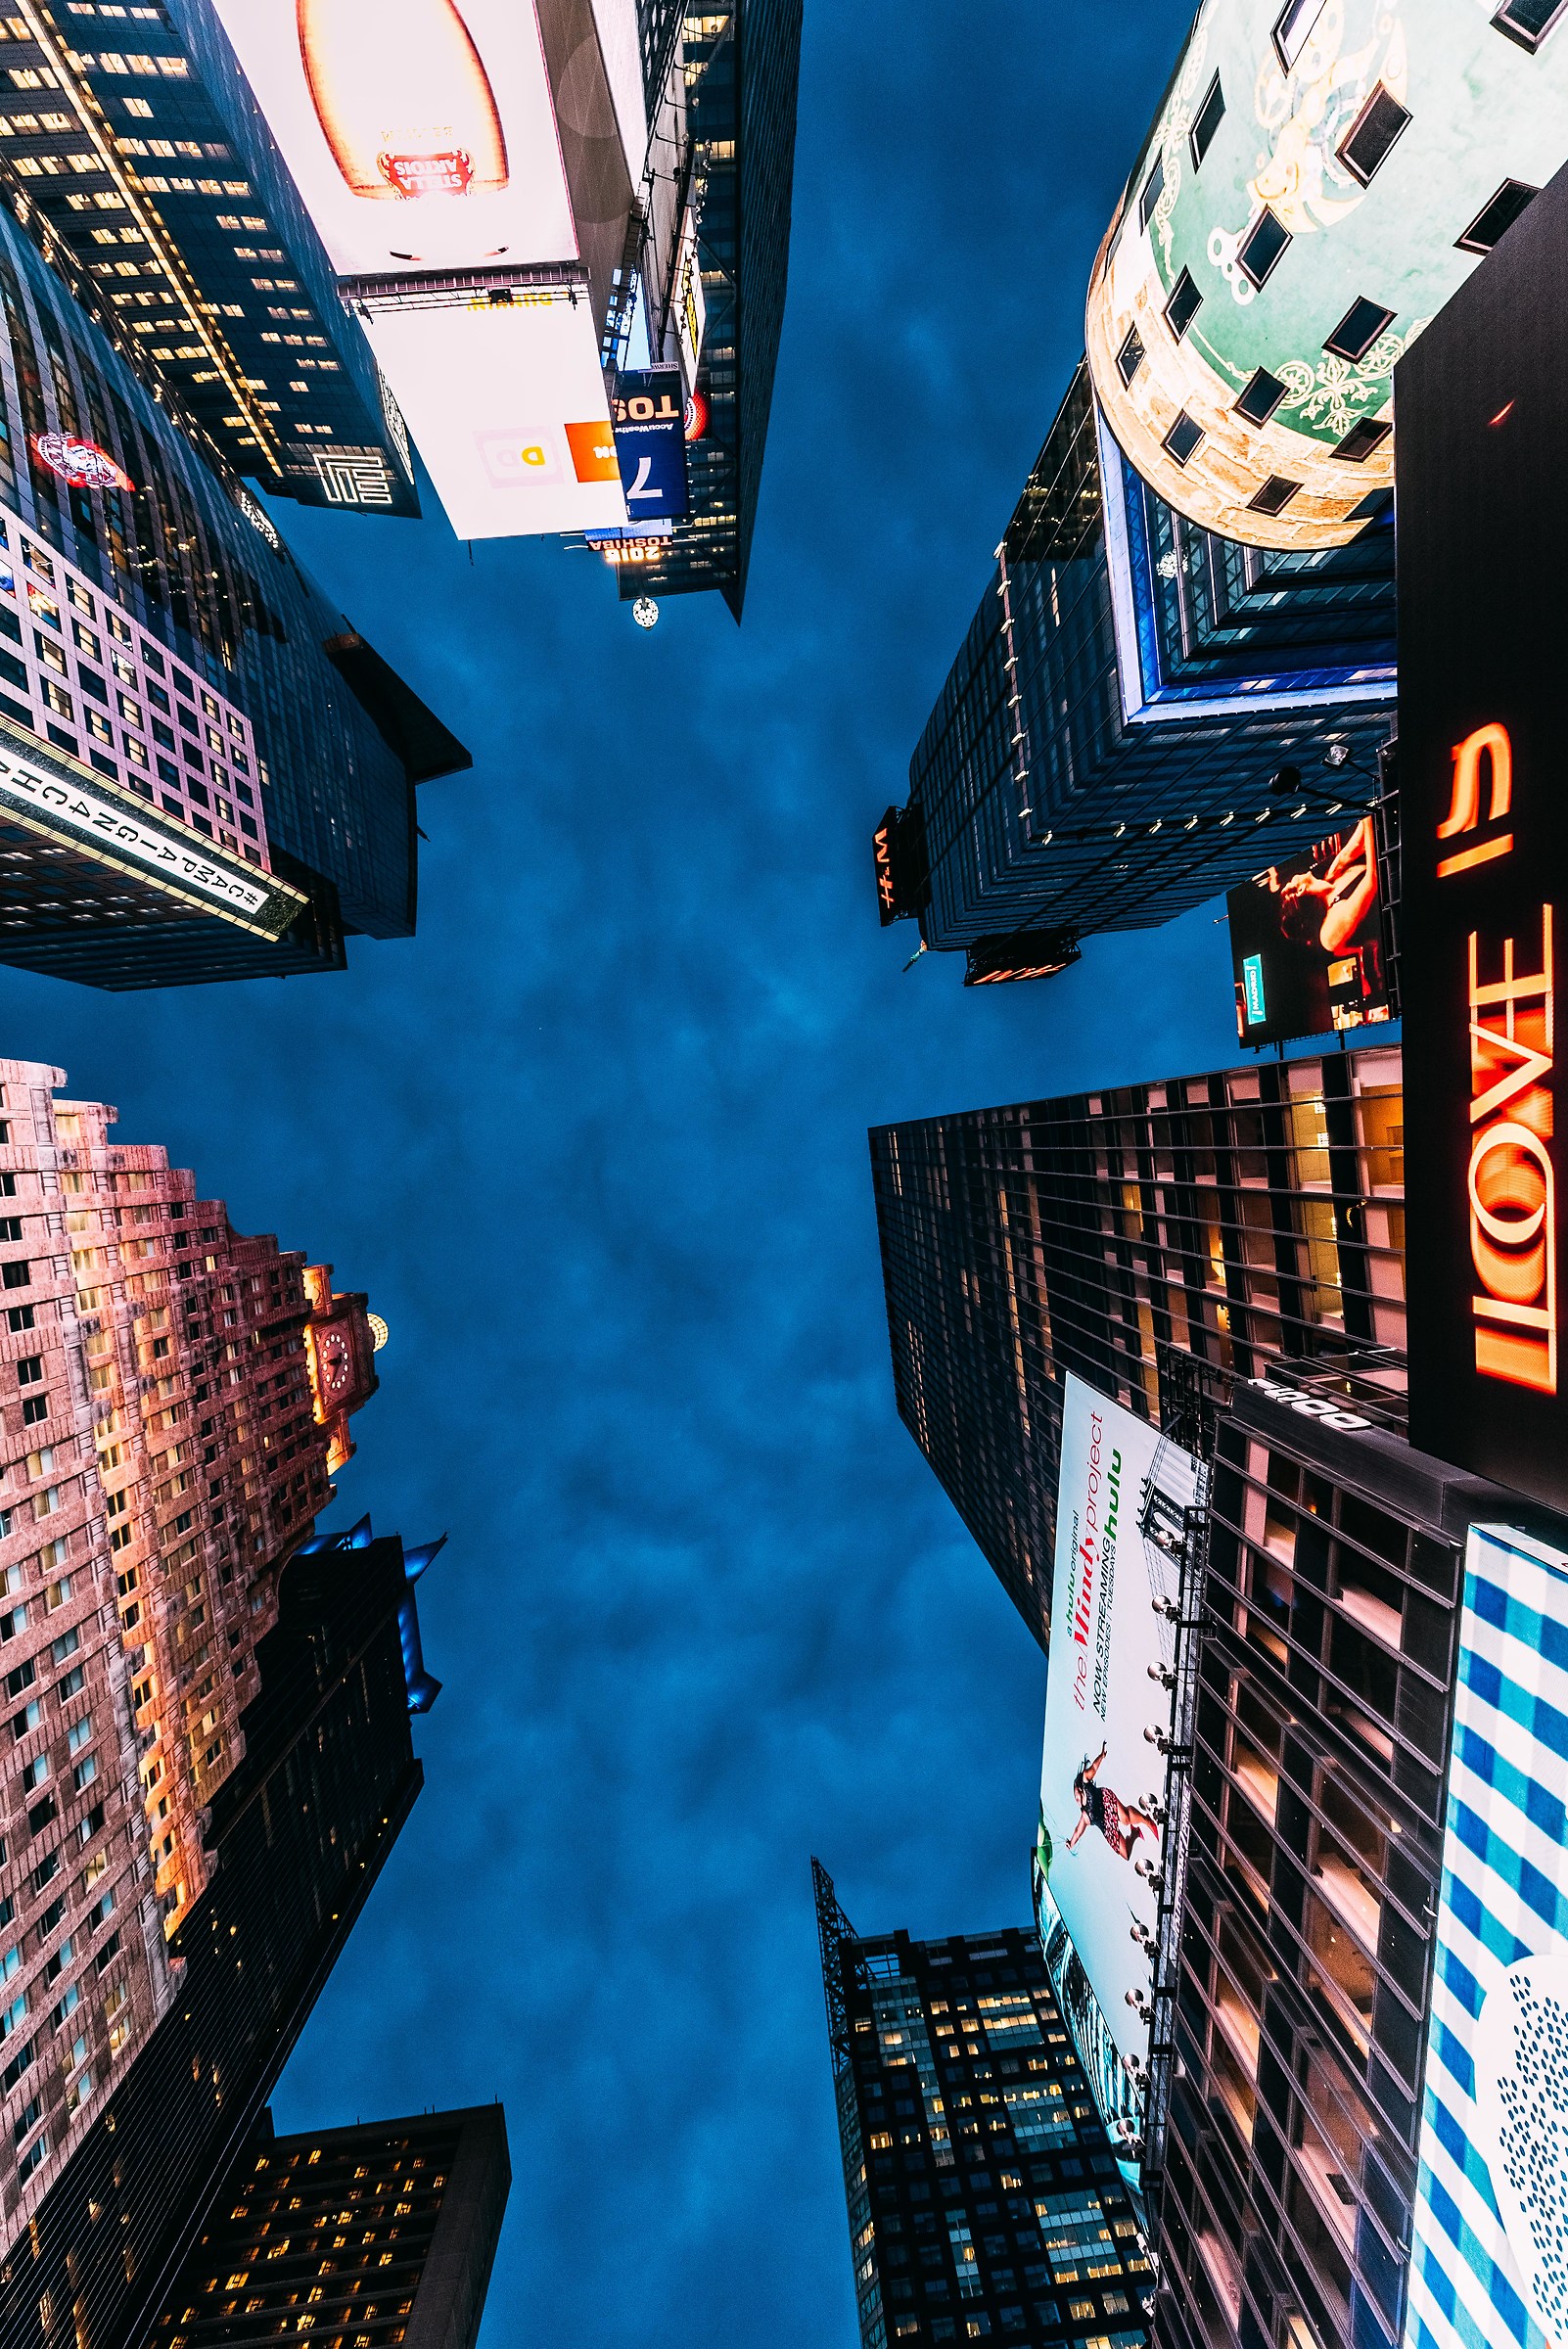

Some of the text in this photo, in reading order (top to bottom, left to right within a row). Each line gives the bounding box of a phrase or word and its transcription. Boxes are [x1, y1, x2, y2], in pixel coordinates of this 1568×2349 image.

[393, 158, 457, 176] ARTOIS
[398, 174, 463, 190] STELLA
[626, 456, 664, 500] 7
[588, 535, 673, 551] TOSHIBA
[604, 545, 662, 563] 2016
[1466, 902, 1556, 1396] LOVE
[1247, 1378, 1372, 1431] 1500
[1069, 1509, 1081, 1572] original
[1072, 1411, 1104, 1712] the Mindy project
[1065, 1572, 1076, 1625] hulu
[1091, 1448, 1123, 1715] NOW STREAMING hulu
[1102, 1622, 1112, 1686] EPISODES
[1107, 1543, 1117, 1611] TUESDAYS
